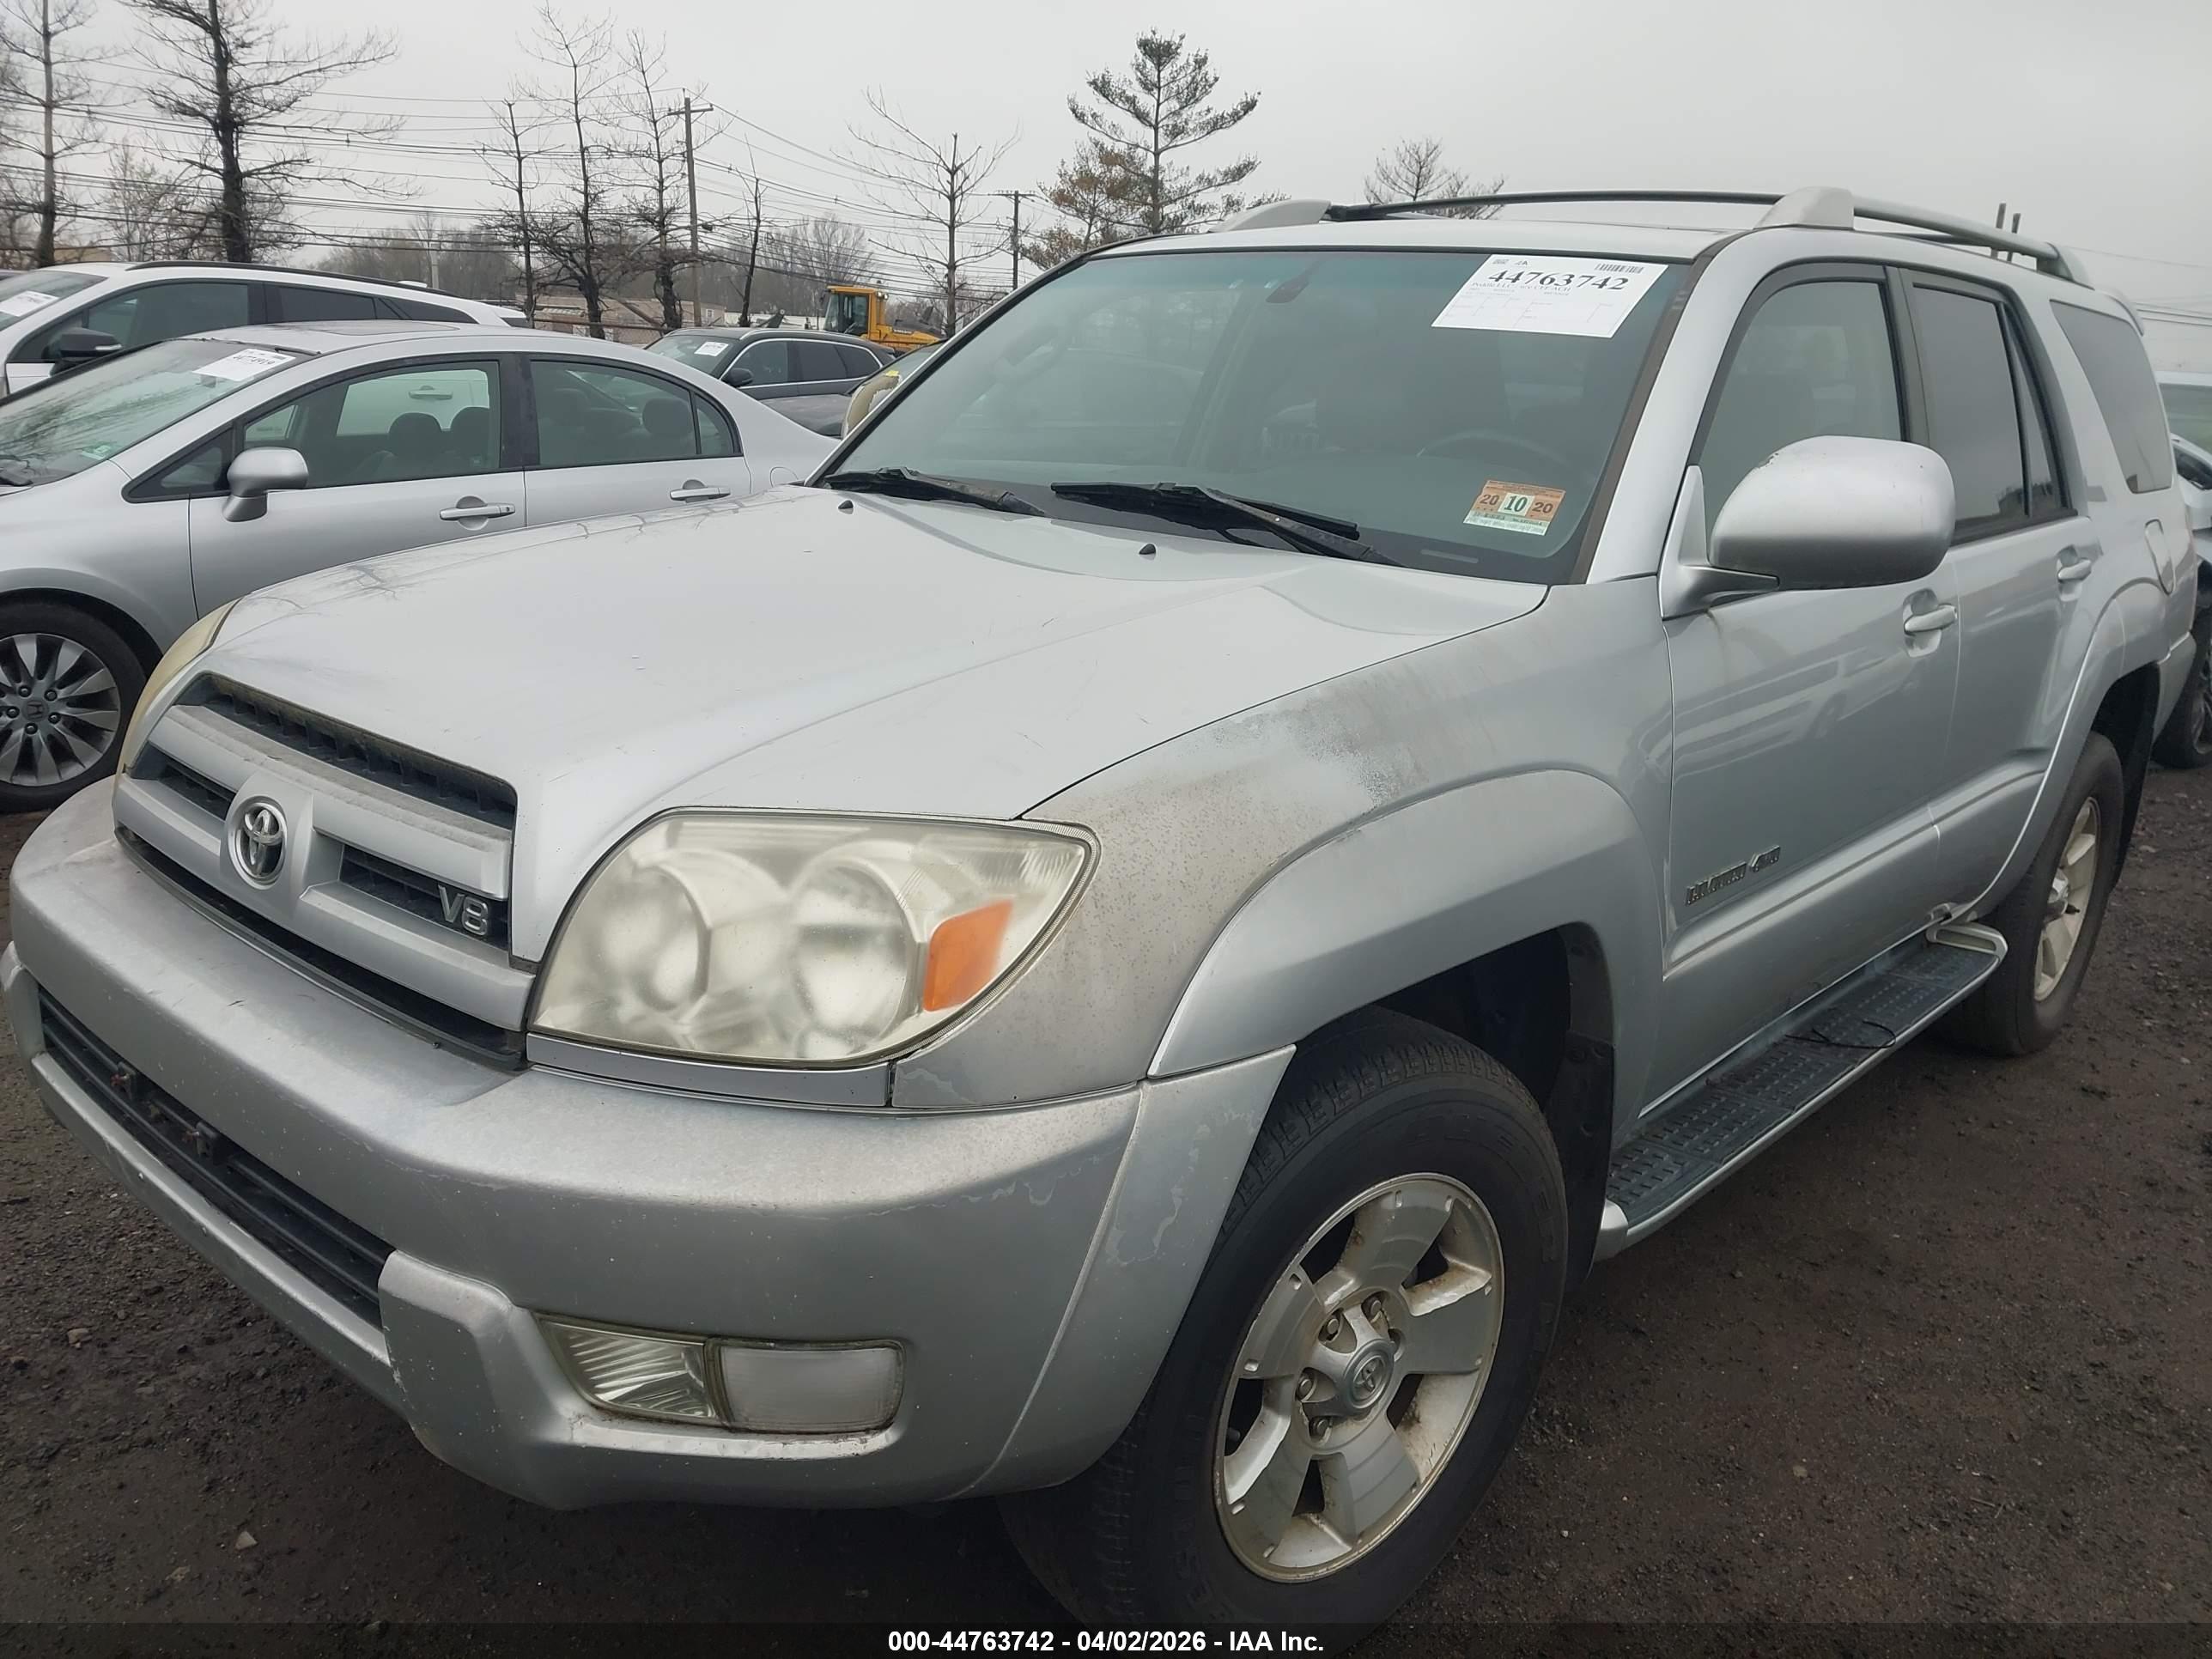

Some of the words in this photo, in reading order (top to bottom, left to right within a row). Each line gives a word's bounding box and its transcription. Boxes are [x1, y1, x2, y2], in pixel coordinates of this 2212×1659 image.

[1488, 270, 1629, 290] 44763742
[1479, 494, 1500, 506] 20
[1504, 495, 1528, 513] 10
[1531, 501, 1553, 514] 20
[437, 884, 489, 936] V8
